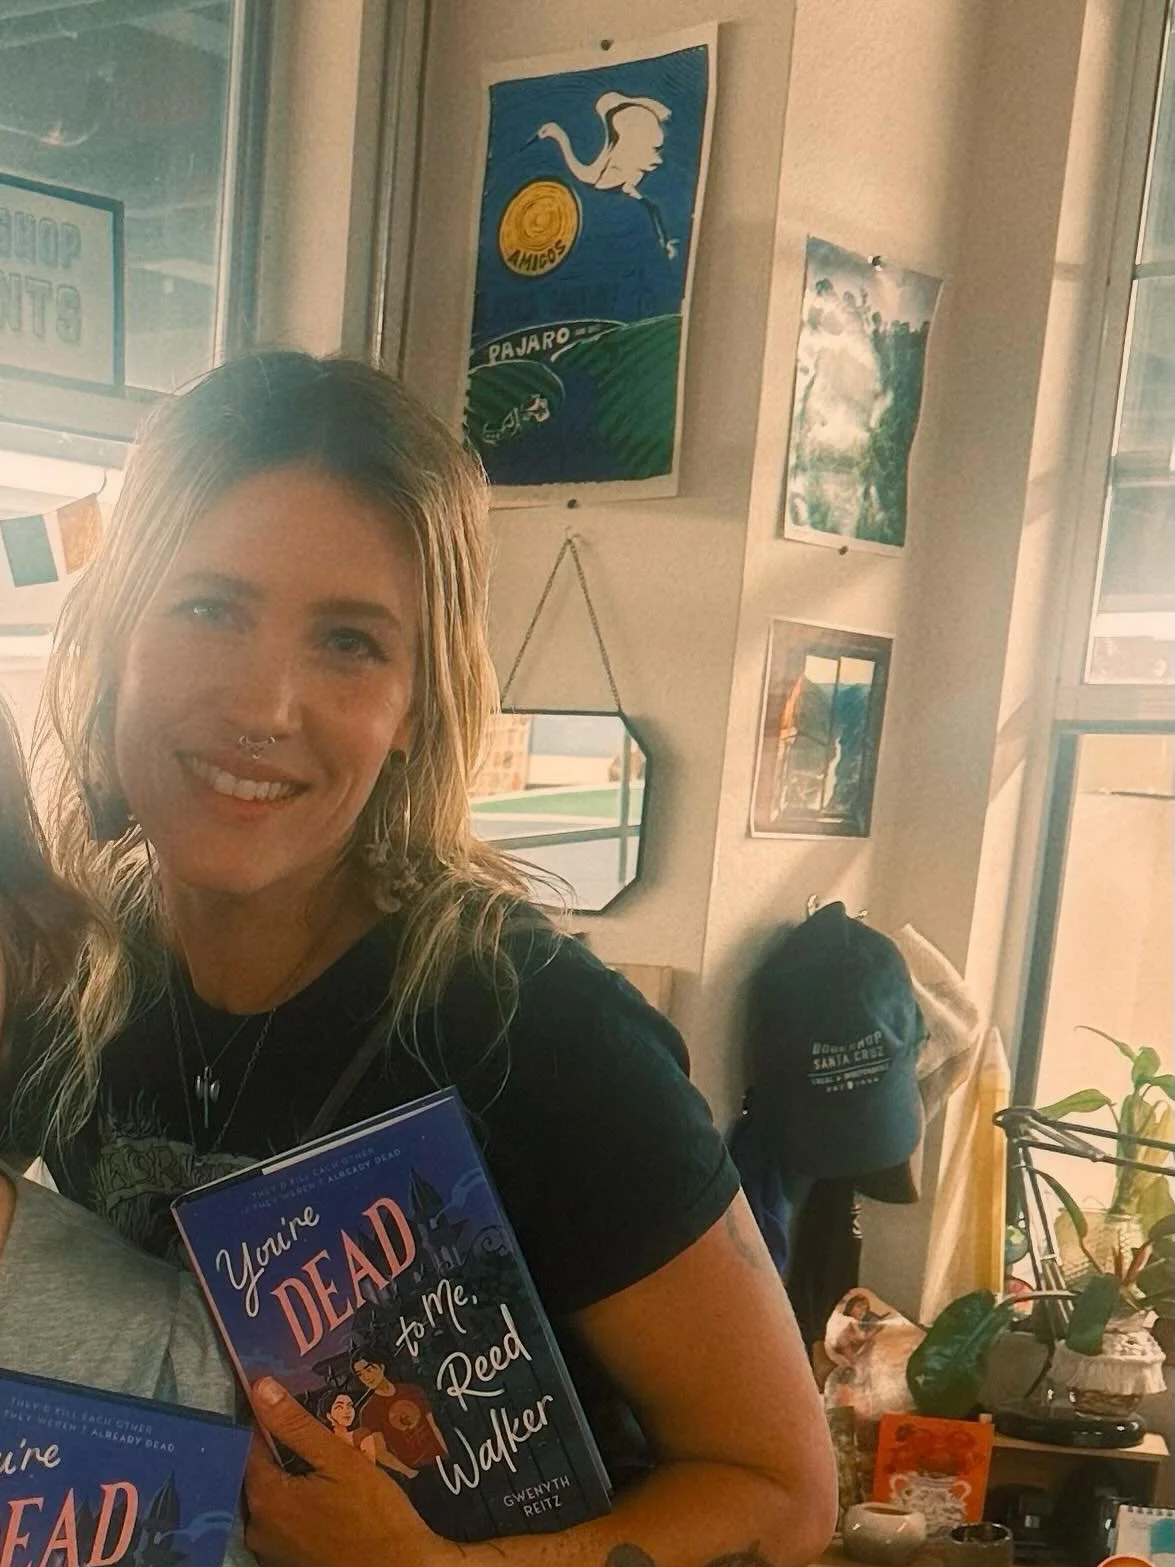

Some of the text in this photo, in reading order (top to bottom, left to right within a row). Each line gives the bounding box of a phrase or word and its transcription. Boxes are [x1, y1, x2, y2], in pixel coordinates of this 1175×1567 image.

[506, 239, 567, 272] AMIGOS
[488, 327, 570, 363] PAJARO
[814, 1053, 850, 1070] SANTA
[375, 1148, 401, 1165] DEAD
[216, 1205, 320, 1317] You're
[271, 1197, 416, 1357] DEAD
[395, 1279, 478, 1357] to Me,
[437, 1303, 532, 1411] Reed
[90, 1428, 141, 1446] ALREADY
[144, 1440, 175, 1454] DEAD
[435, 1394, 553, 1496] Walker
[503, 1475, 571, 1508] GWENYTH
[524, 1495, 562, 1517] REITZ
